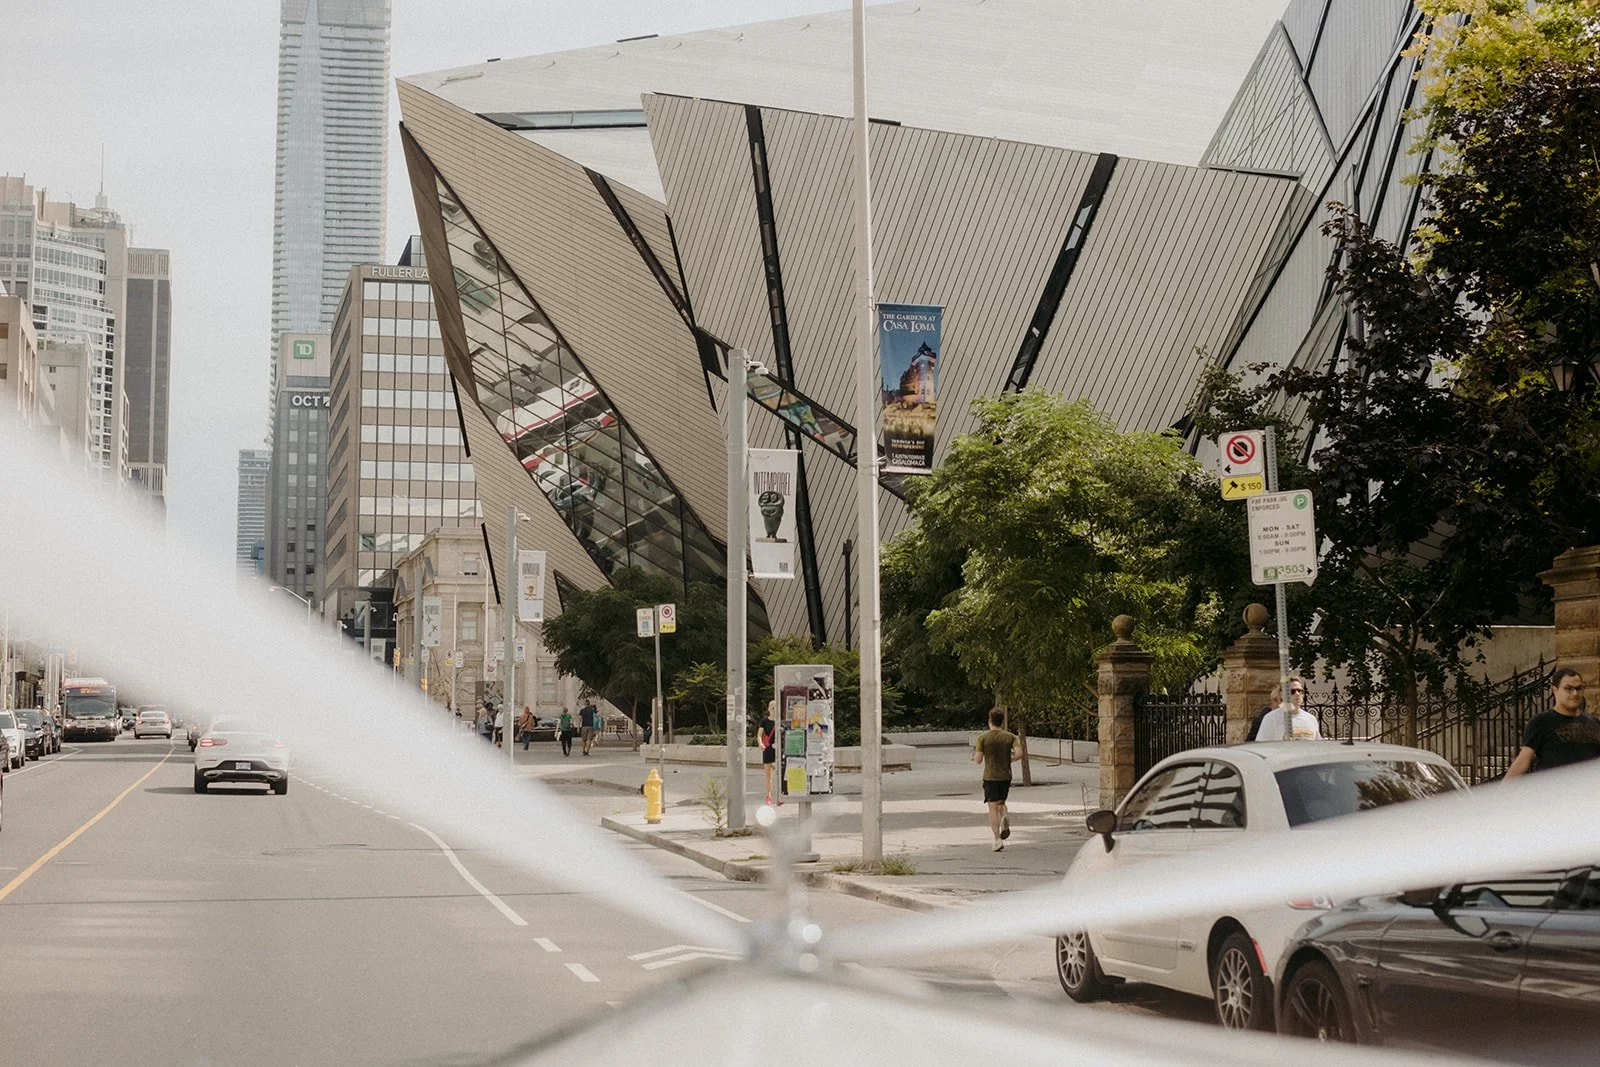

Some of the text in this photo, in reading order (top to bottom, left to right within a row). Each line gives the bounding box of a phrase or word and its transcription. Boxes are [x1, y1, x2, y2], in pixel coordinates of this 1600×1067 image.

[371, 266, 413, 278] FULLER
[883, 319, 936, 333] CASA LOMA
[296, 343, 313, 355] TD
[1248, 482, 1262, 490] 150
[1286, 523, 1300, 531] SAT
[1278, 564, 1305, 575] 3503
